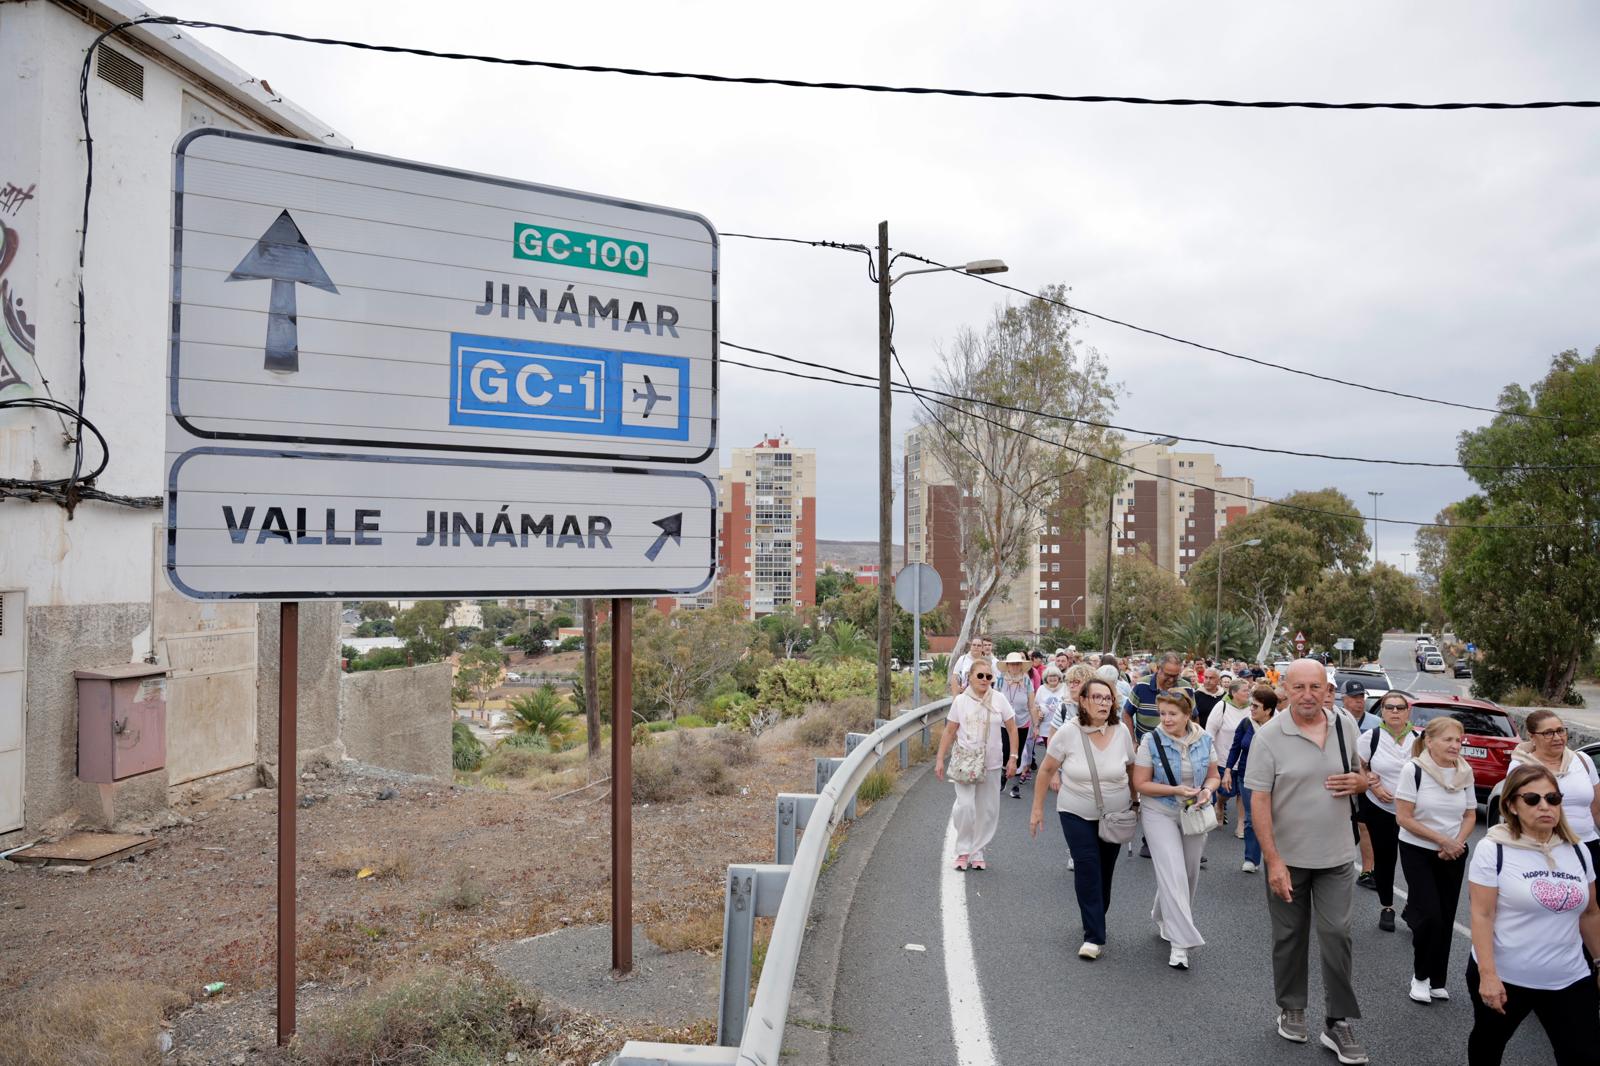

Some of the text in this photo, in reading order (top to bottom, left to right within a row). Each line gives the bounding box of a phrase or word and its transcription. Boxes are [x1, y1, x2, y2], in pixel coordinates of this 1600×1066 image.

[517, 227, 646, 272] GC-100
[475, 280, 680, 339] JINÁMAR
[469, 358, 596, 411] GC-1
[221, 504, 613, 549] VALLE JINÁMAR
[1522, 871, 1582, 883] HAPPY DREAMS
